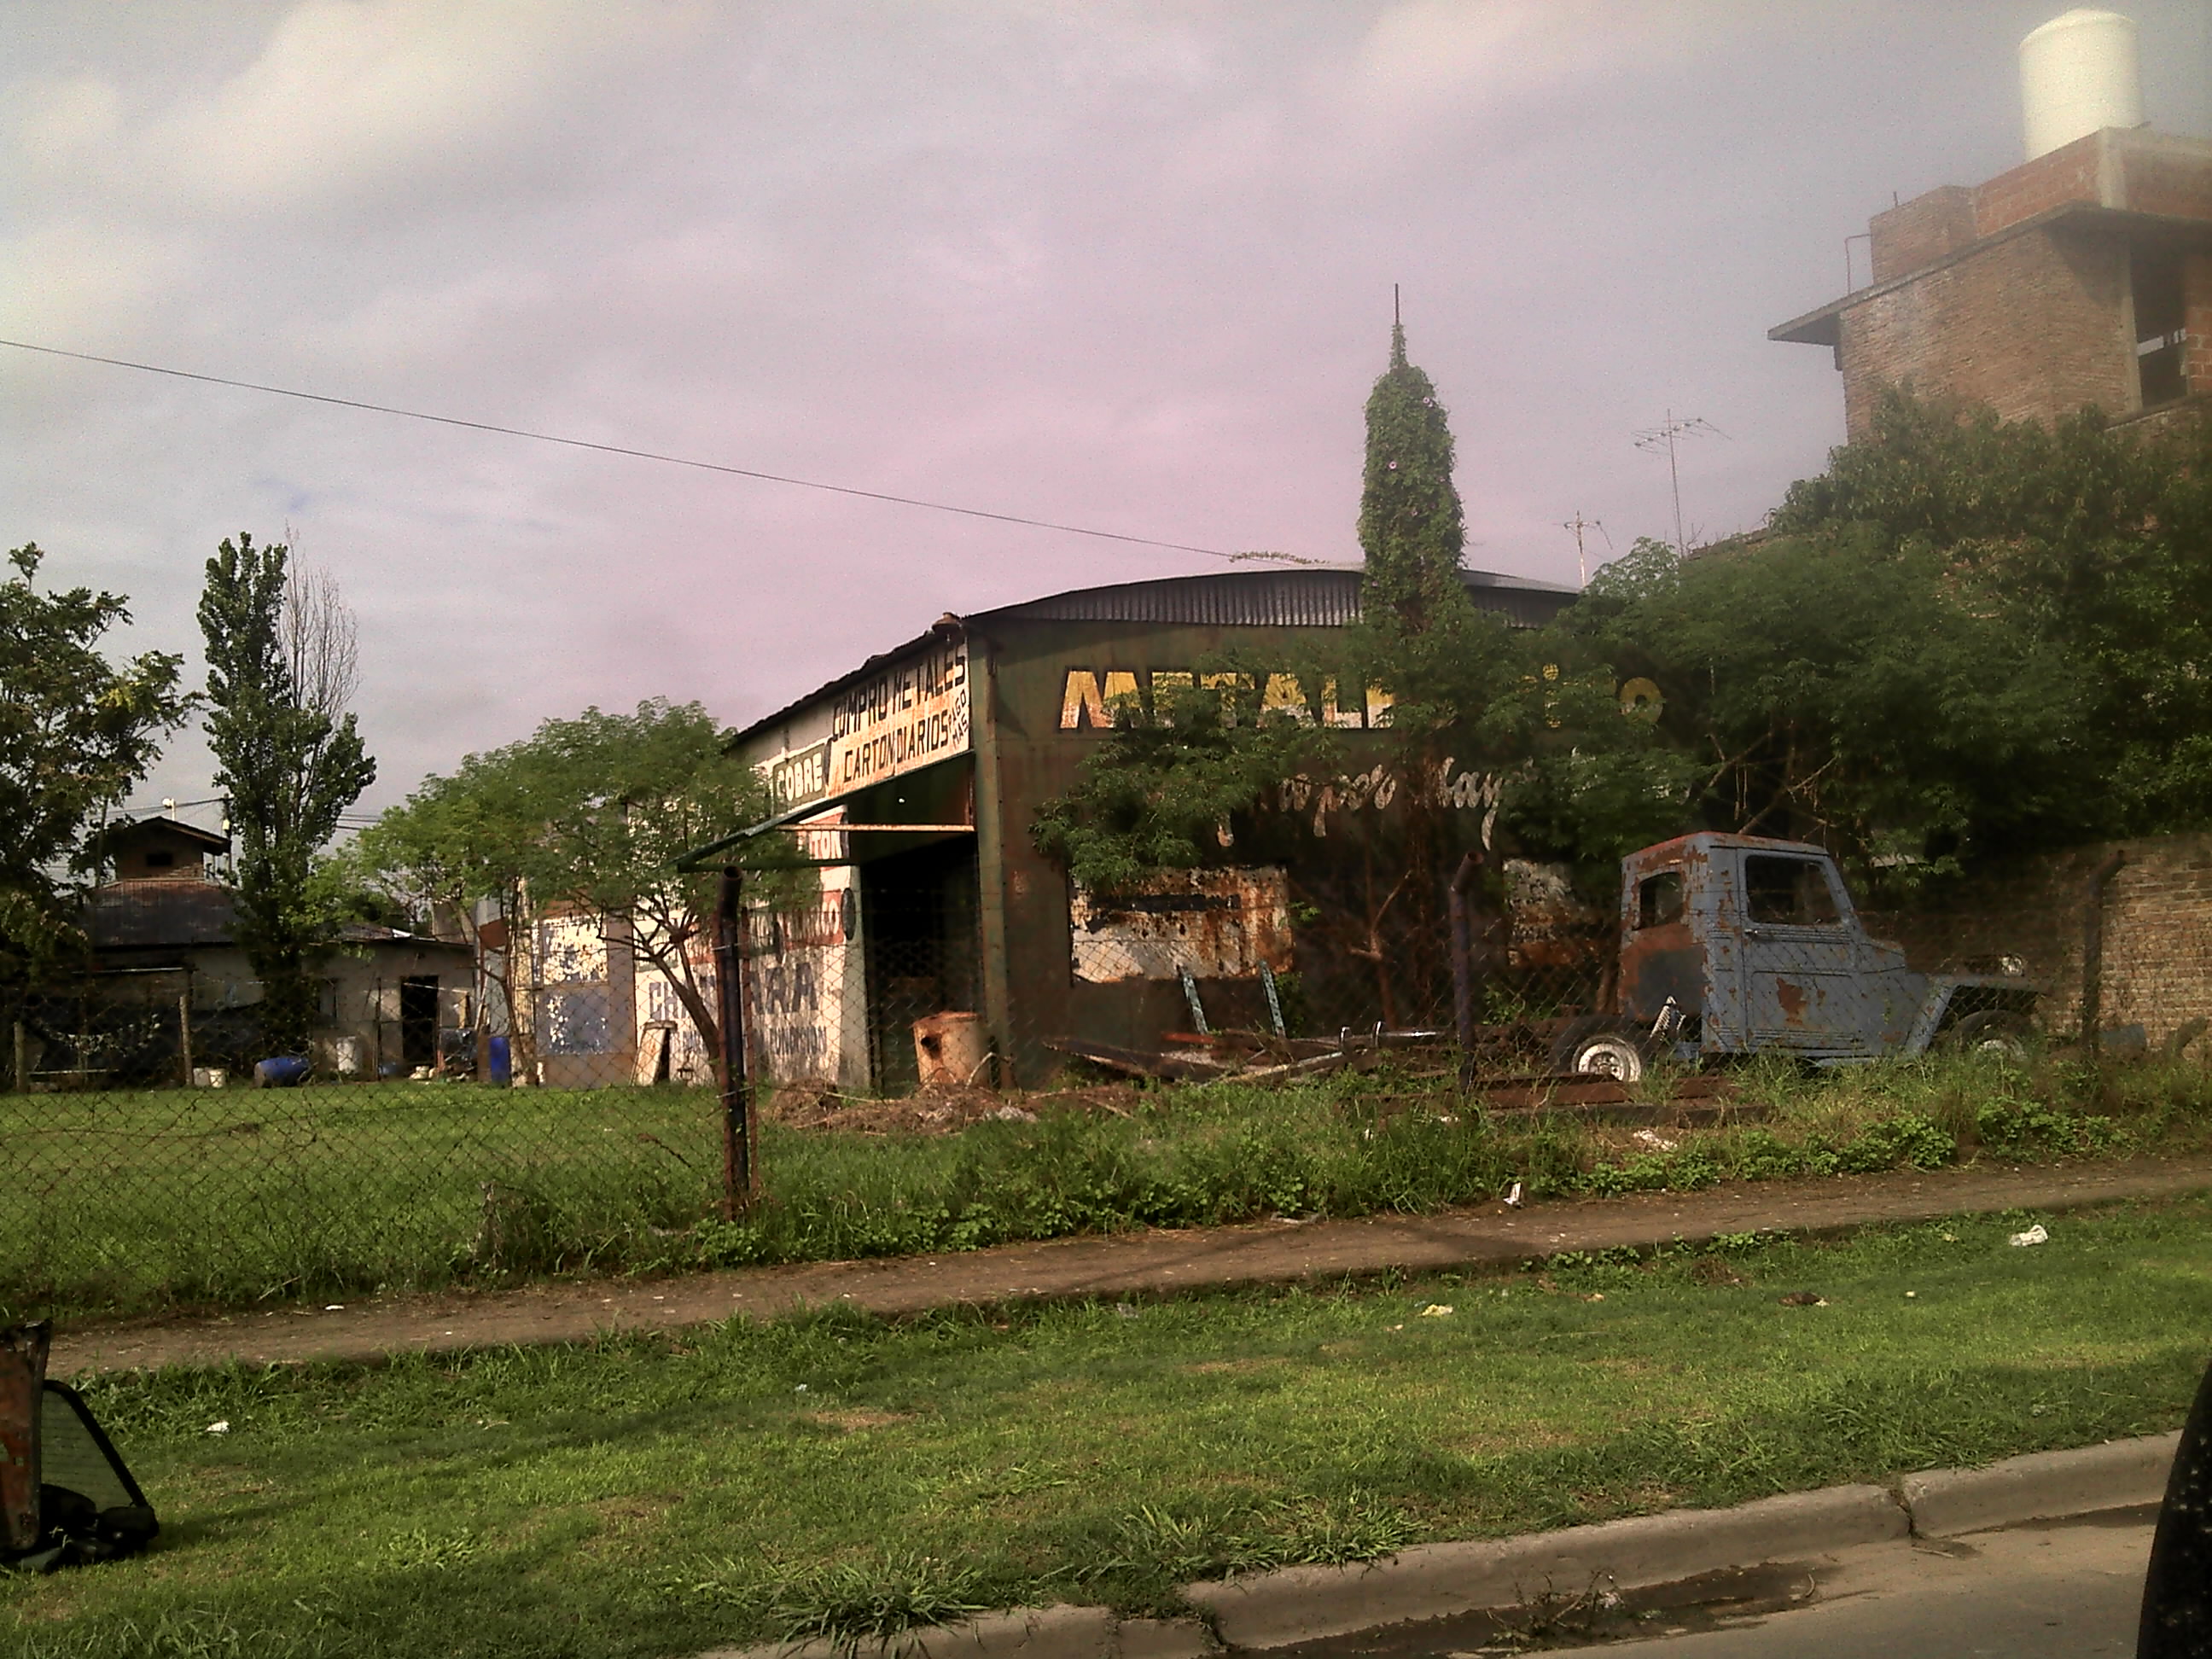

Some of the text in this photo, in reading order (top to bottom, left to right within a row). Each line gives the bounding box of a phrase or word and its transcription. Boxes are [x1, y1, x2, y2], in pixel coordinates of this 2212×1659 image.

[831, 646, 966, 742] COMPRO METALES
[777, 752, 823, 802] COBRE
[843, 709, 949, 783] CARTON DIARIOS
